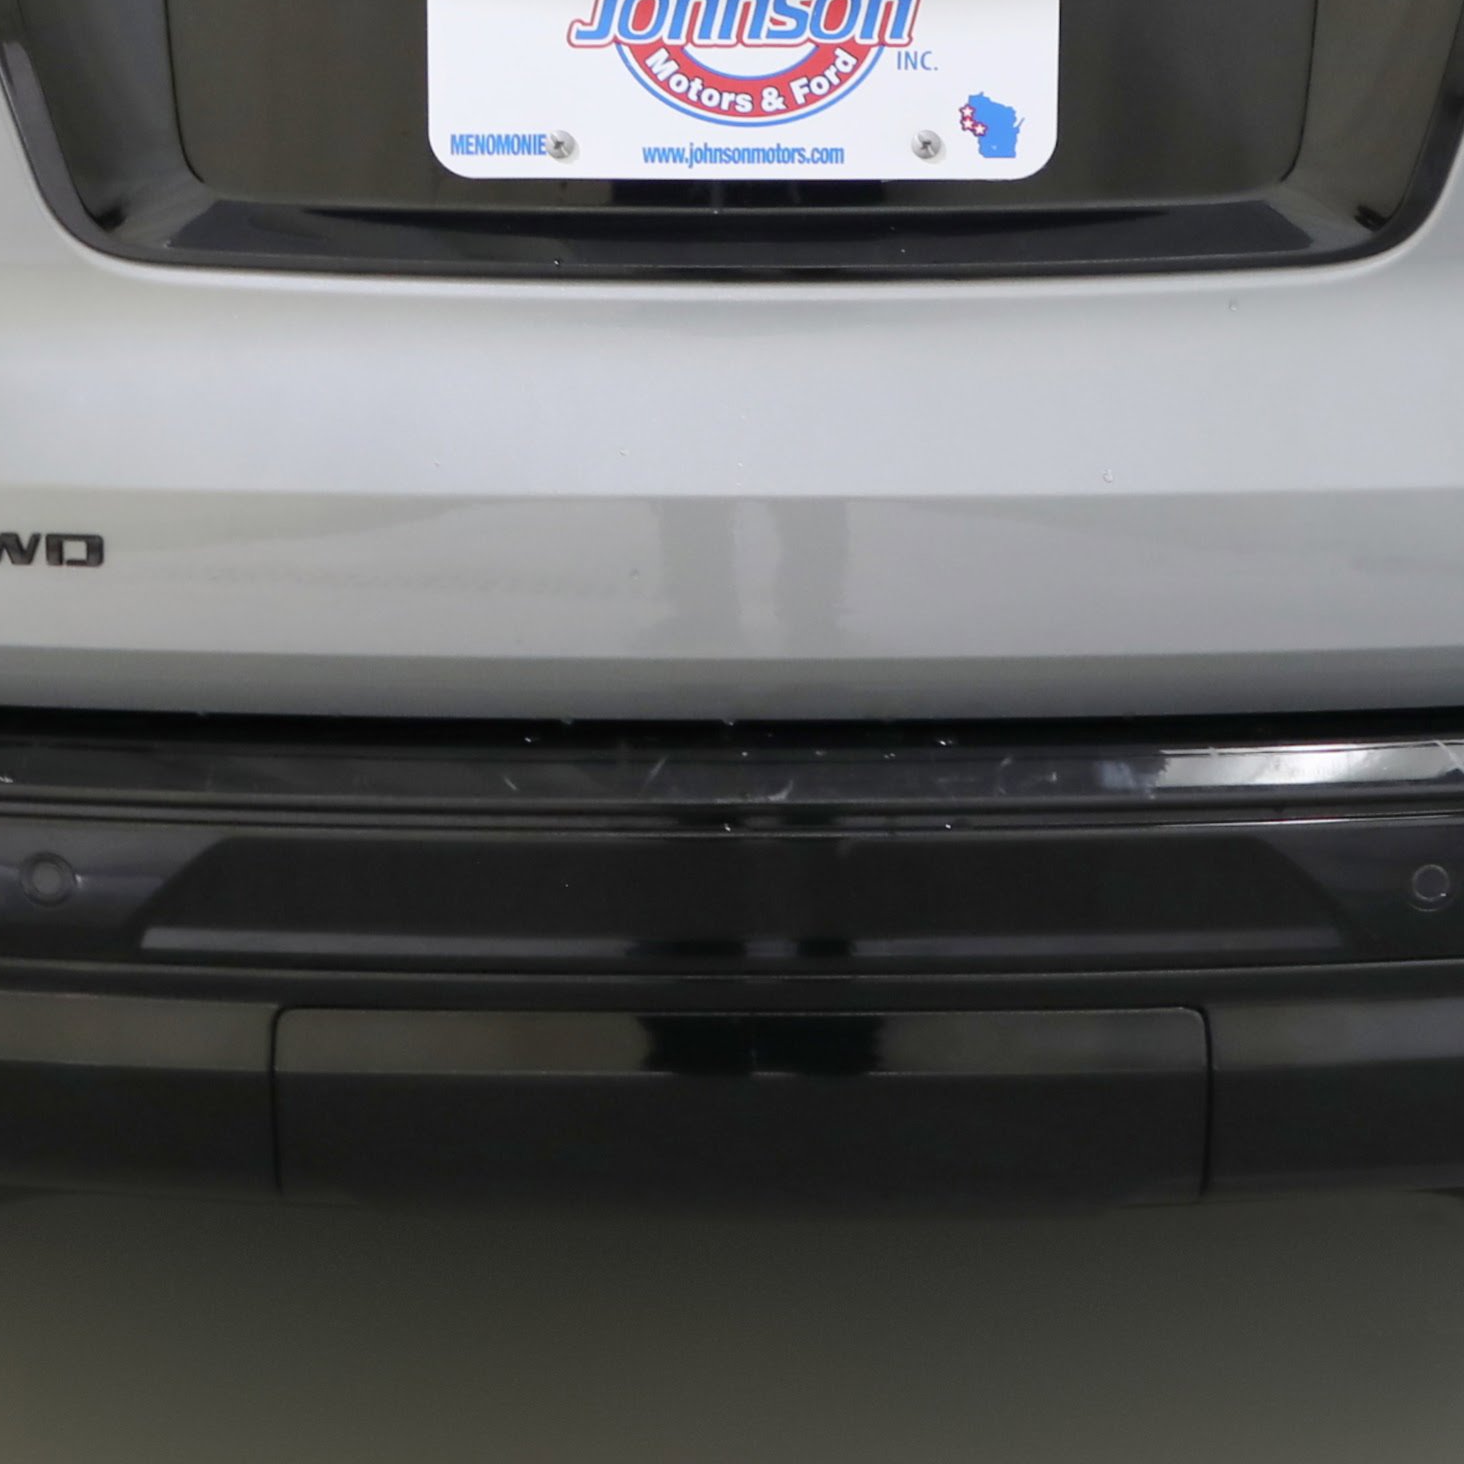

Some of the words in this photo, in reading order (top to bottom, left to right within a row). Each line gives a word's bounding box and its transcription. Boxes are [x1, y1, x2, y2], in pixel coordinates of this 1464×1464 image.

[896, 50, 939, 72] INC.
[644, 47, 754, 114] Motors
[760, 86, 788, 113] &
[789, 47, 858, 105] Ford
[449, 133, 548, 156] MENOMONIE
[641, 142, 845, 169] www.johnsonmotors.com
